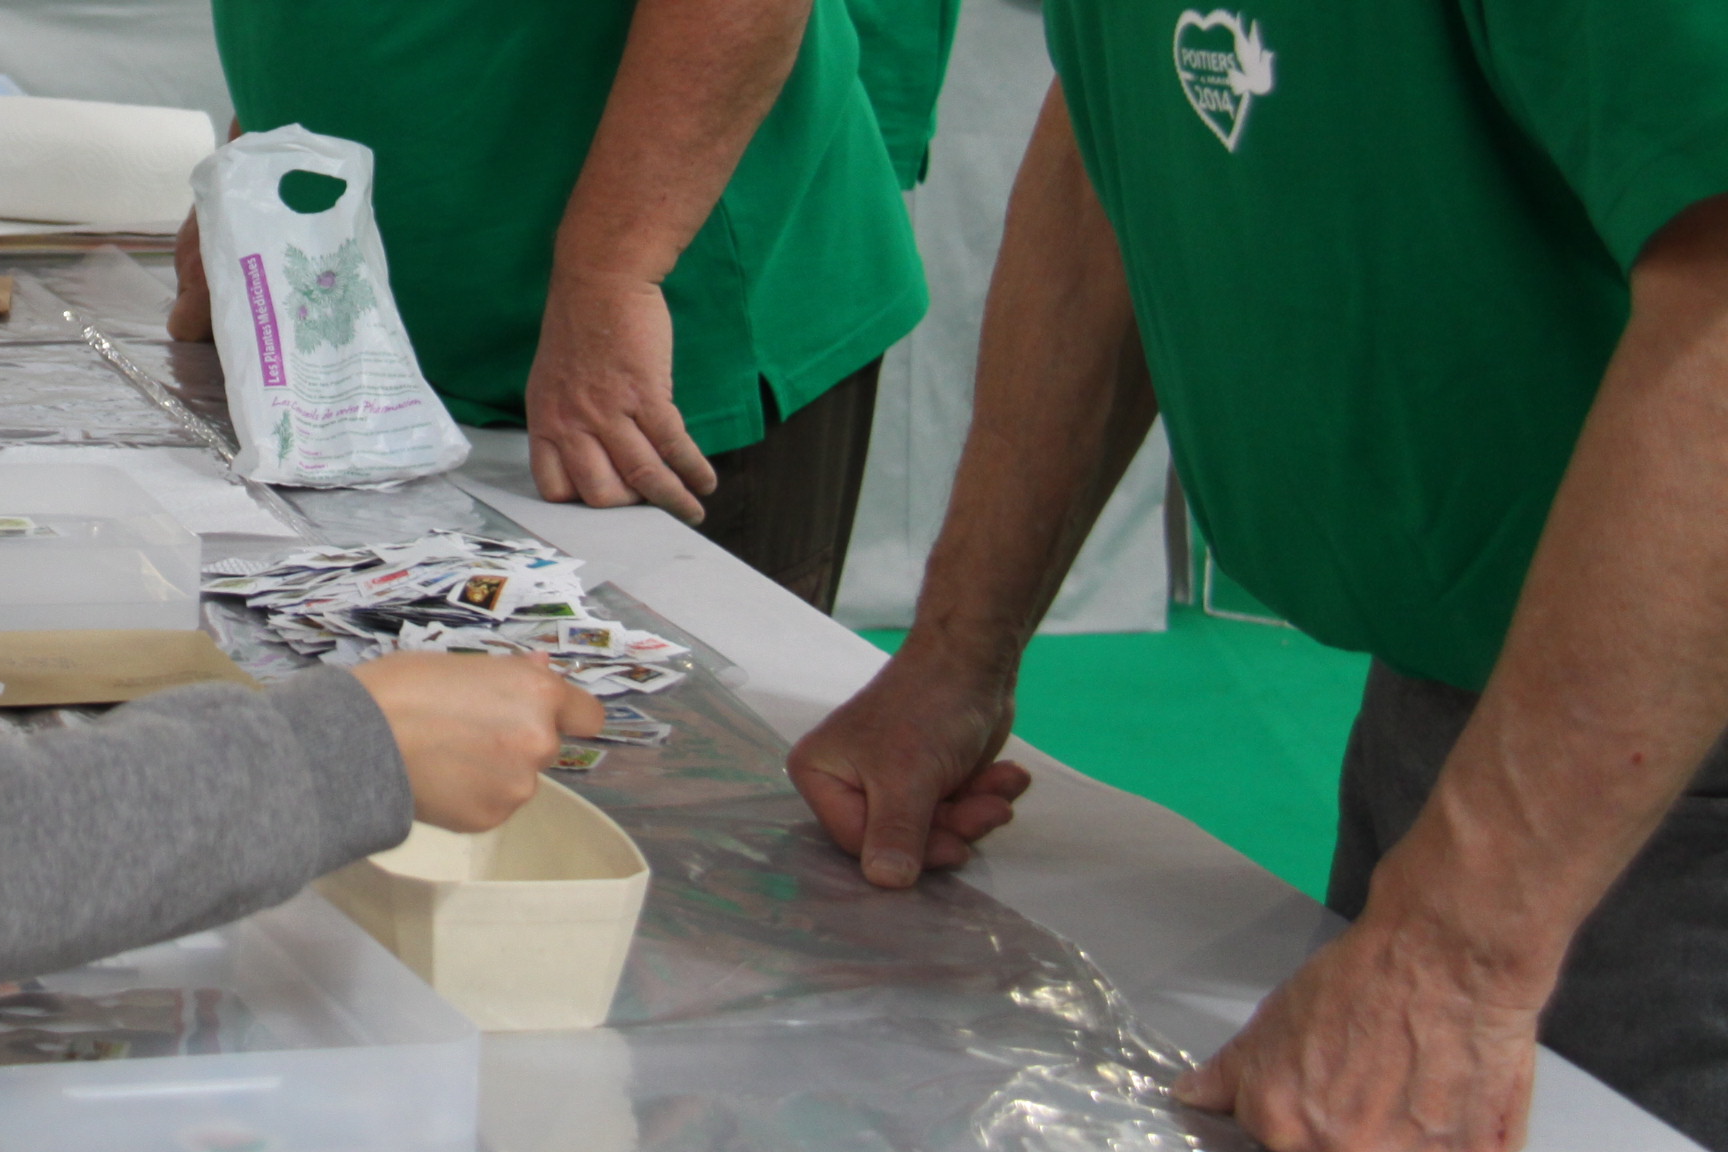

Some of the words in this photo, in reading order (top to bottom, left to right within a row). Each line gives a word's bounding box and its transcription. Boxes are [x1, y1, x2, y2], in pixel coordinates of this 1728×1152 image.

[1181, 48, 1234, 72] POITIERS
[1194, 85, 1234, 120] 2014
[247, 257, 270, 324] Médicinales
[262, 324, 277, 363] Plantes
[268, 365, 280, 384] Les
